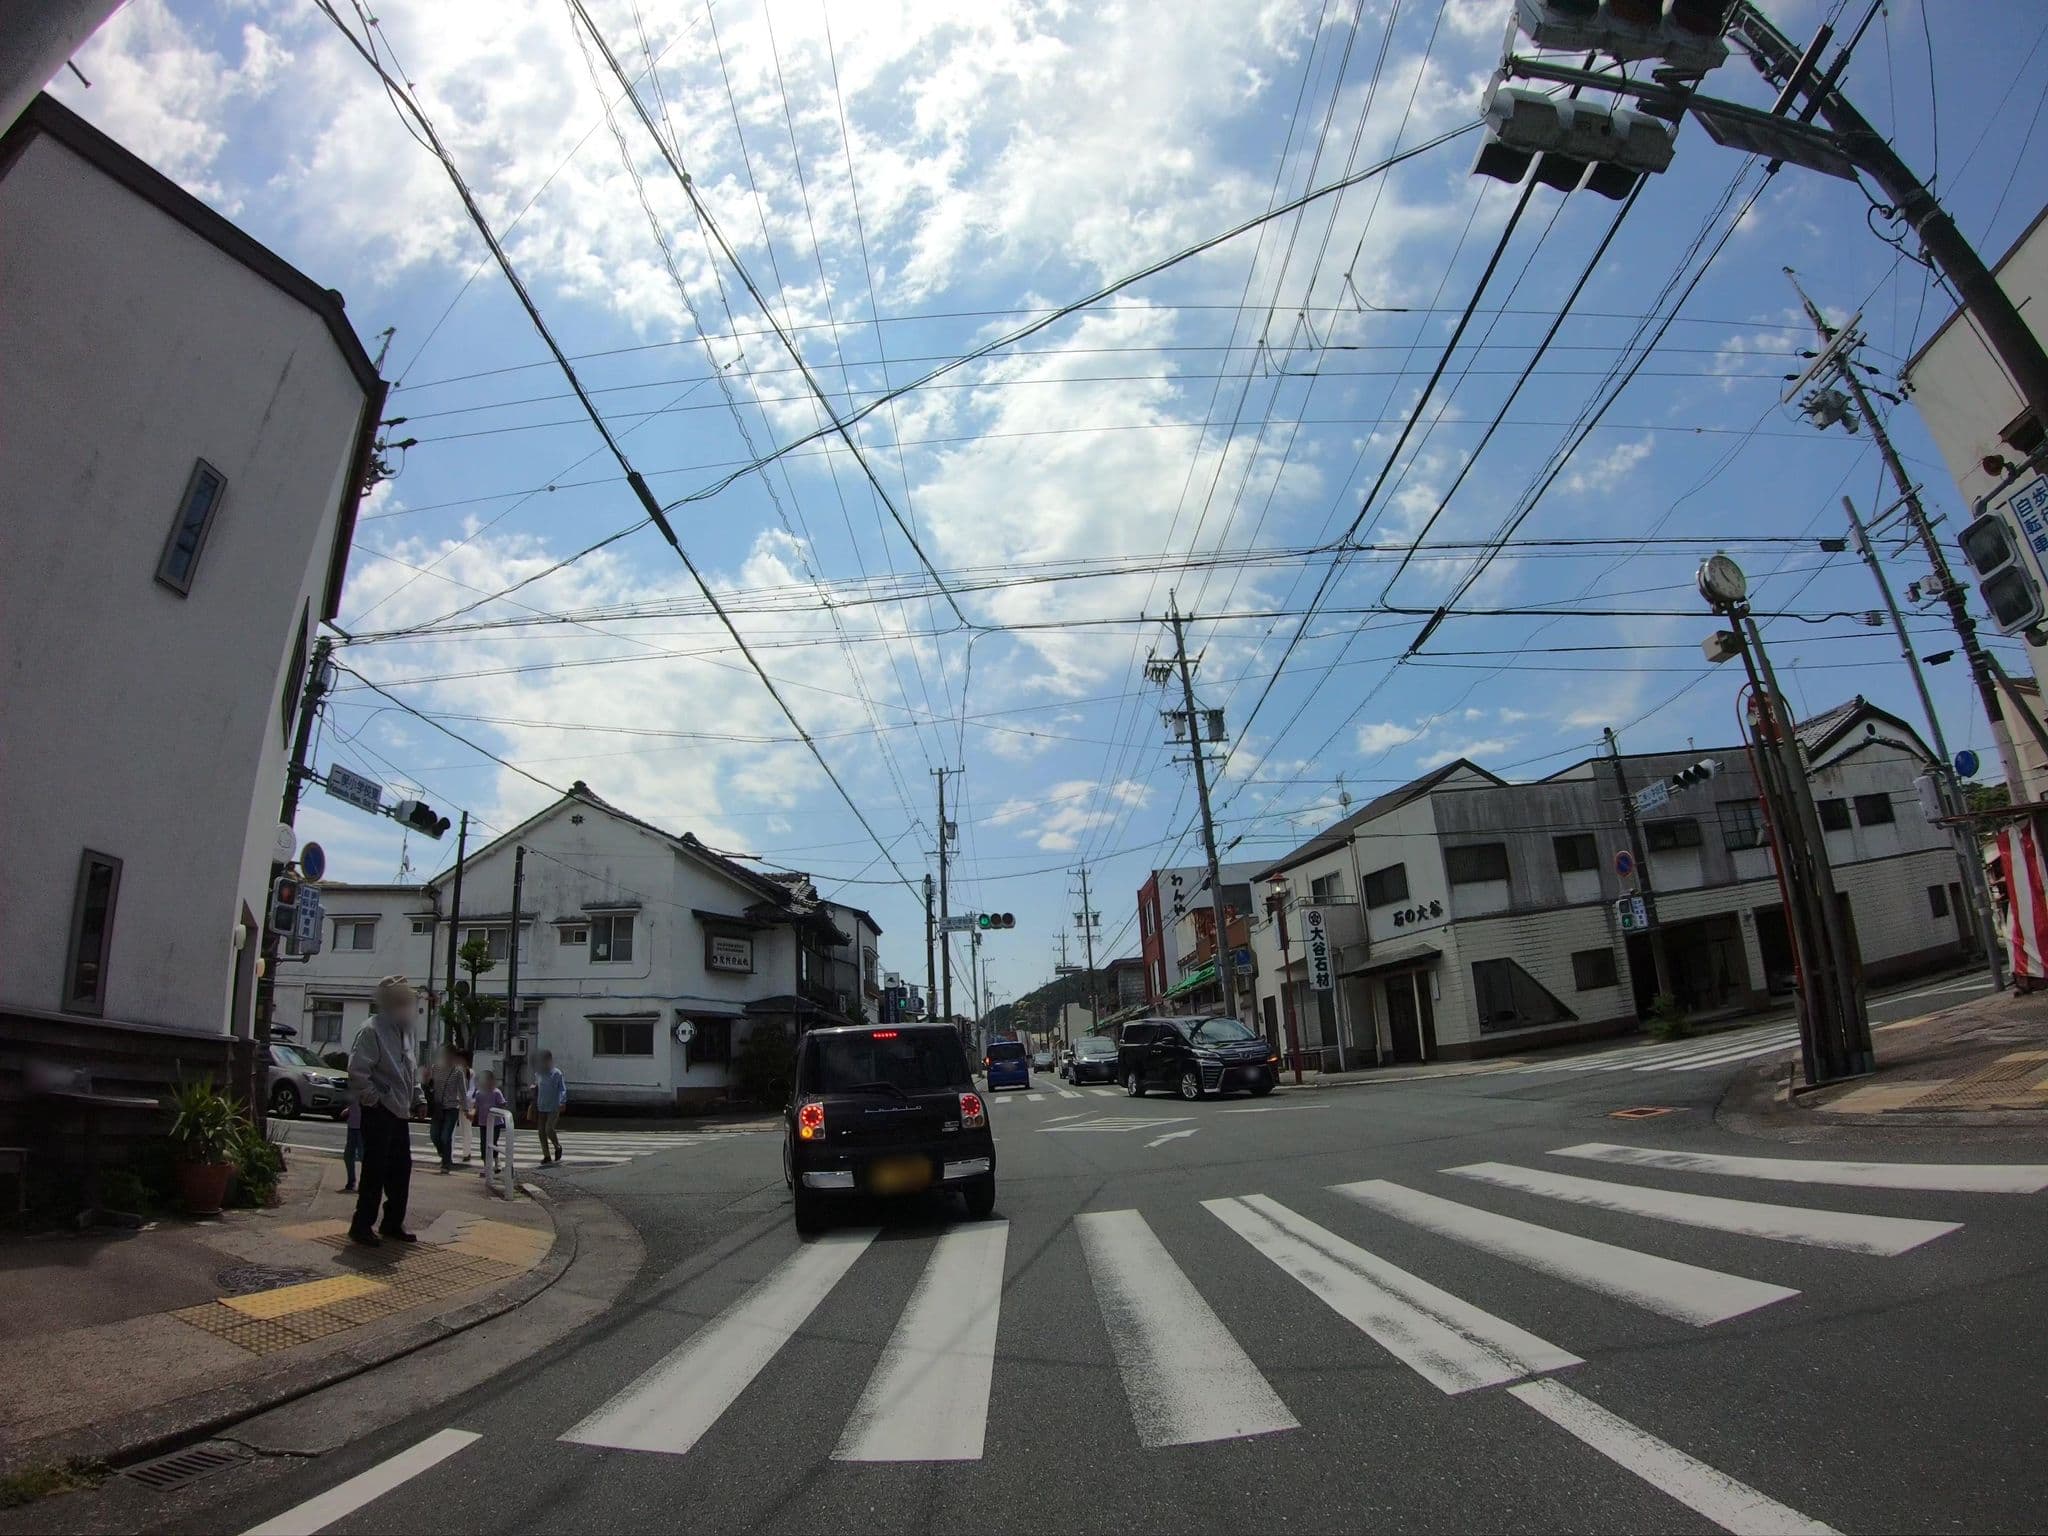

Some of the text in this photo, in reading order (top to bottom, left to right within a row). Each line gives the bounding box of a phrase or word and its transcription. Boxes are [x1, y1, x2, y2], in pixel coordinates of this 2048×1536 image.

[1393, 900, 1443, 927] 石の大谷
[1311, 927, 1330, 987] 大谷石材
